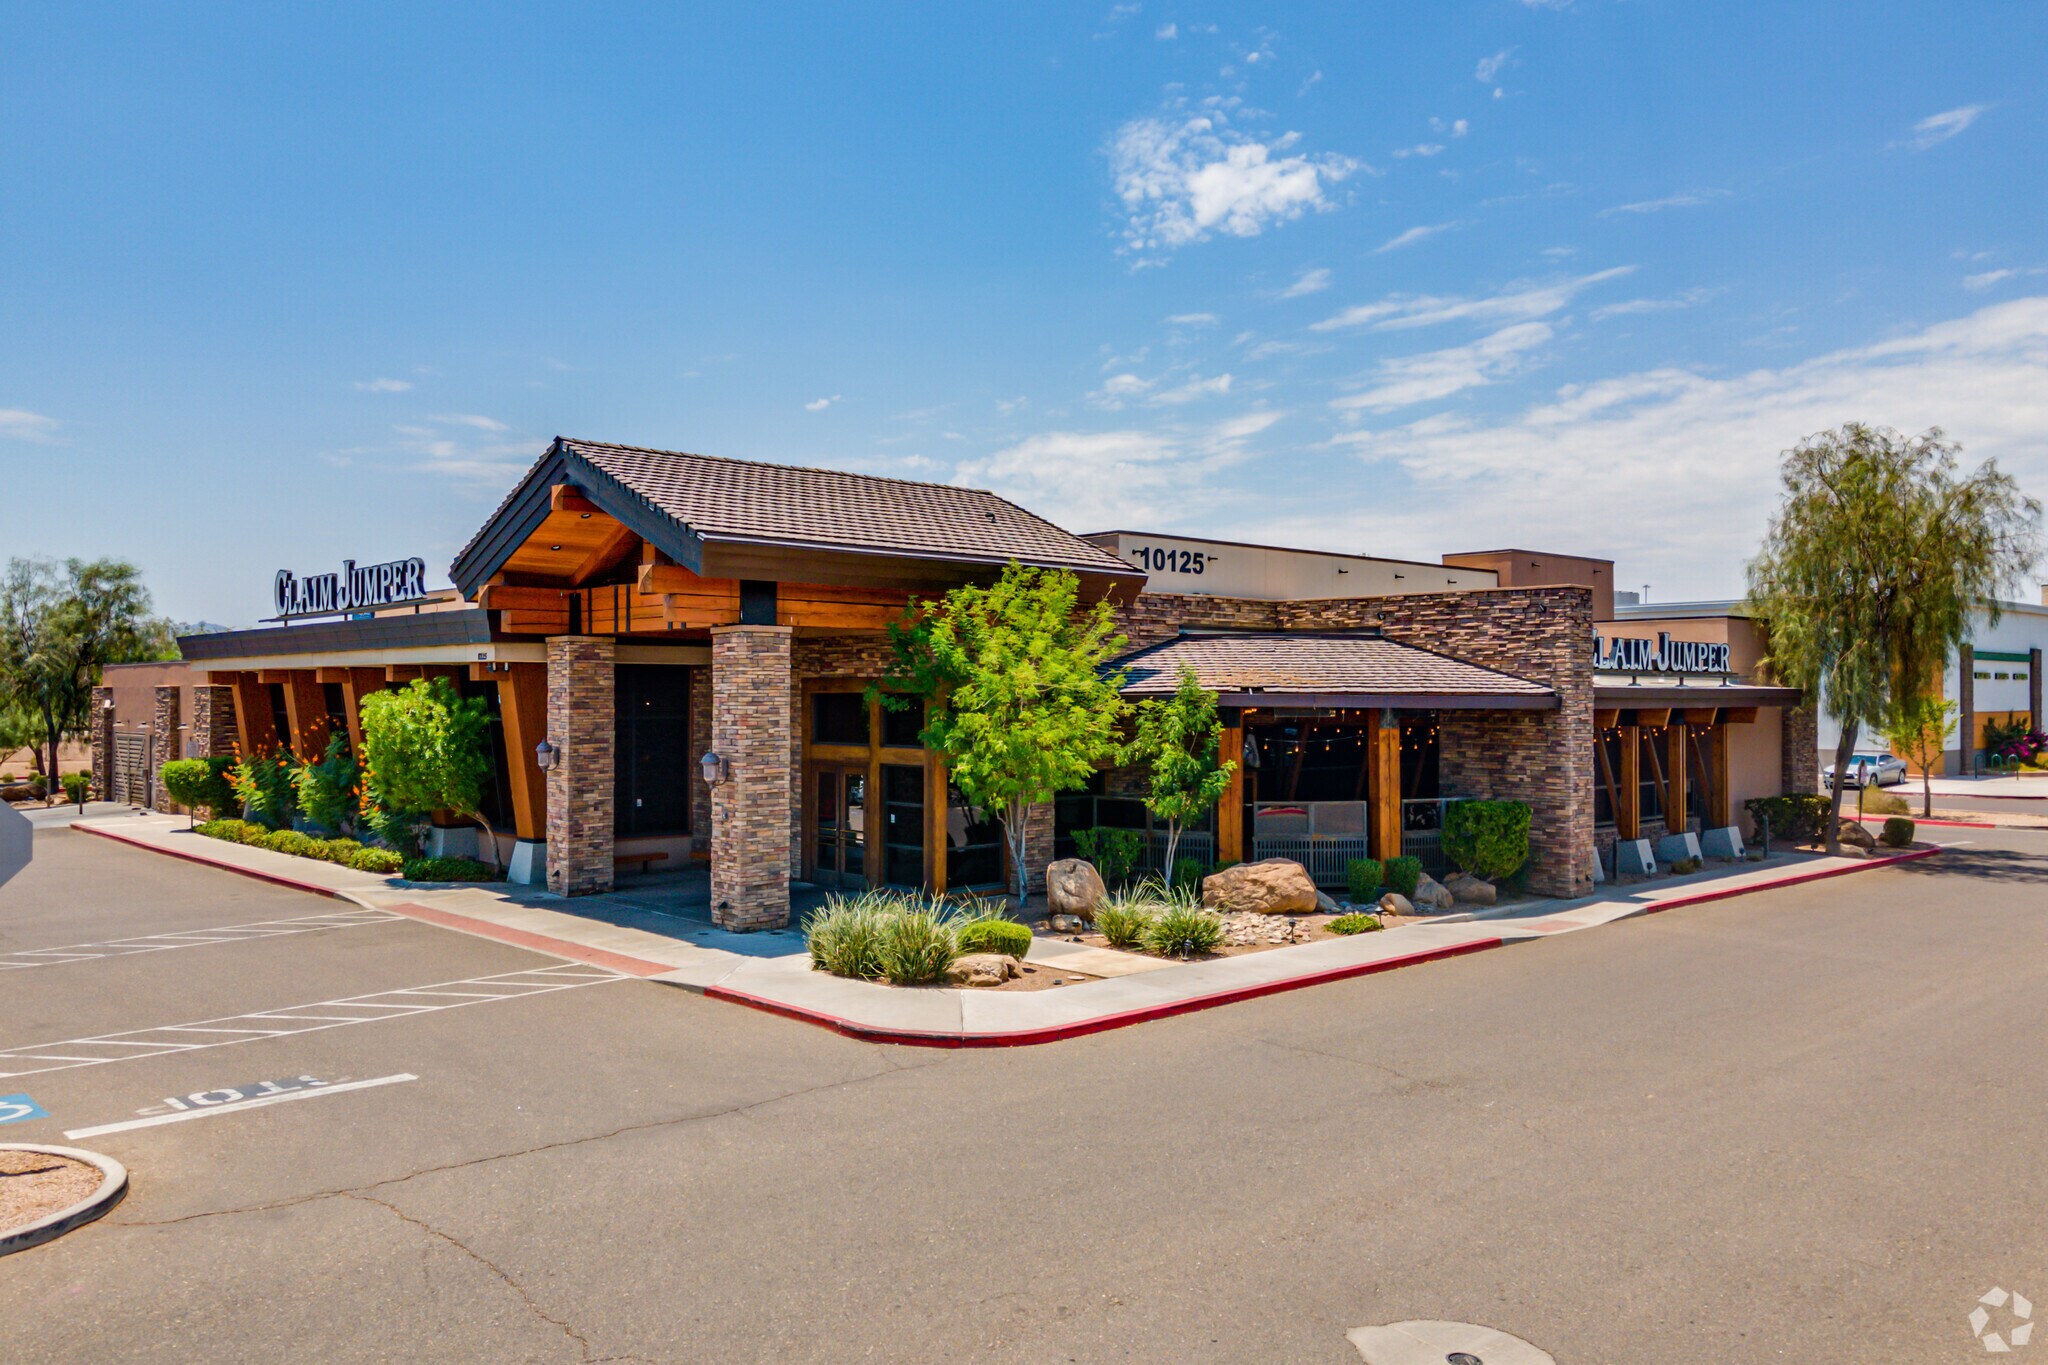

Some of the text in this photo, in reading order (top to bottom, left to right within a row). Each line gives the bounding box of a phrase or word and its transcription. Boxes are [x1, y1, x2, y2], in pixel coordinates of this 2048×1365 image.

[1141, 547, 1204, 574] 10125
[274, 557, 428, 617] CLAIM JUMPER
[1657, 631, 1732, 673] JUMPER
